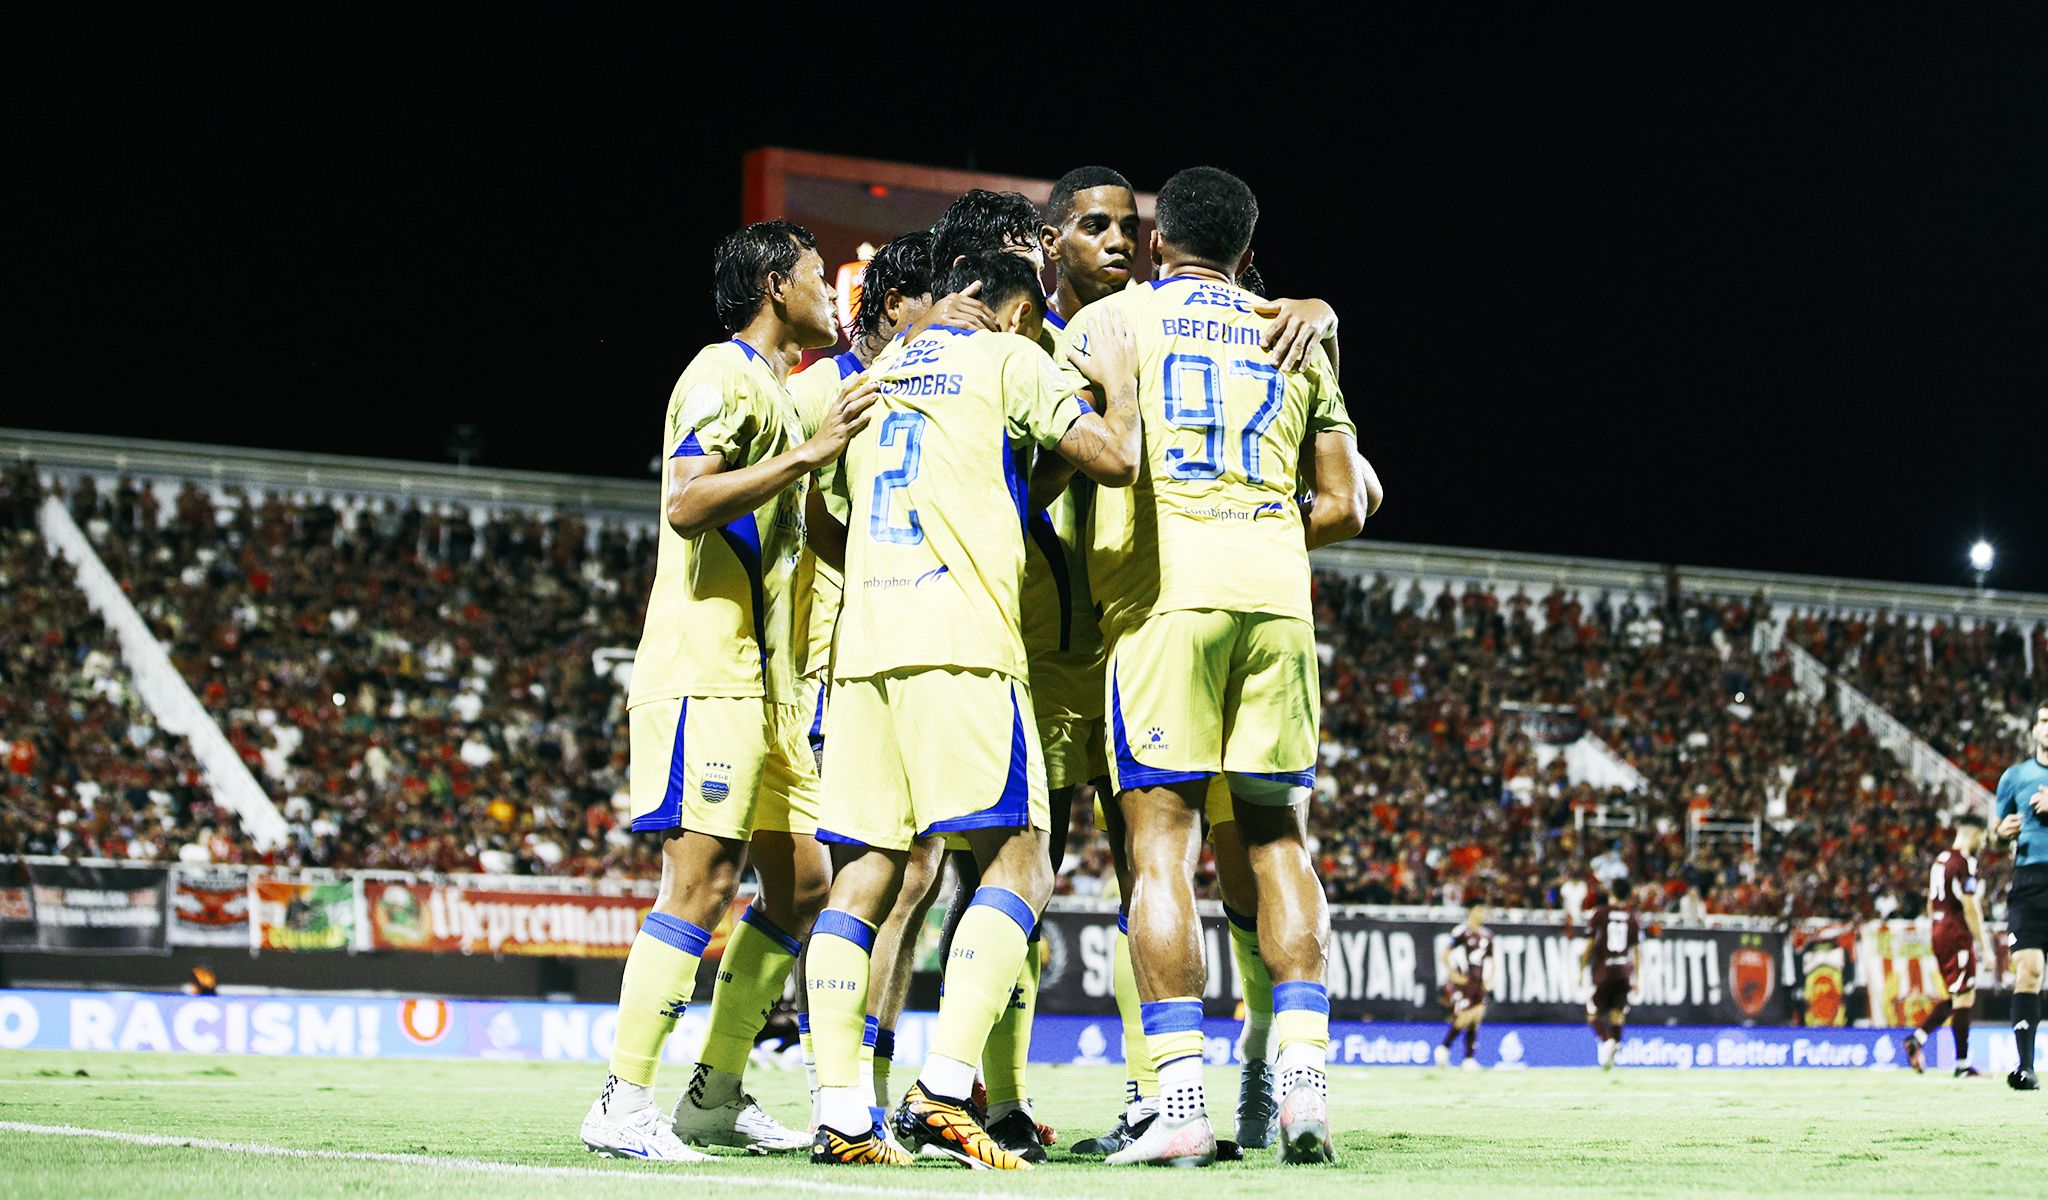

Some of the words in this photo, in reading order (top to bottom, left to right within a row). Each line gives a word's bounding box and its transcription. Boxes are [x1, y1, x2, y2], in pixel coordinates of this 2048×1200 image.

[1163, 352, 1285, 485] 97
[868, 412, 927, 546] 2
[807, 979, 857, 991] ERSIB
[69, 999, 381, 1057] RACISM!
[1344, 1034, 1431, 1064] Future
[1695, 1043, 1714, 1066] a
[1717, 1038, 1789, 1066] Better
[1793, 1038, 1868, 1067] Future
